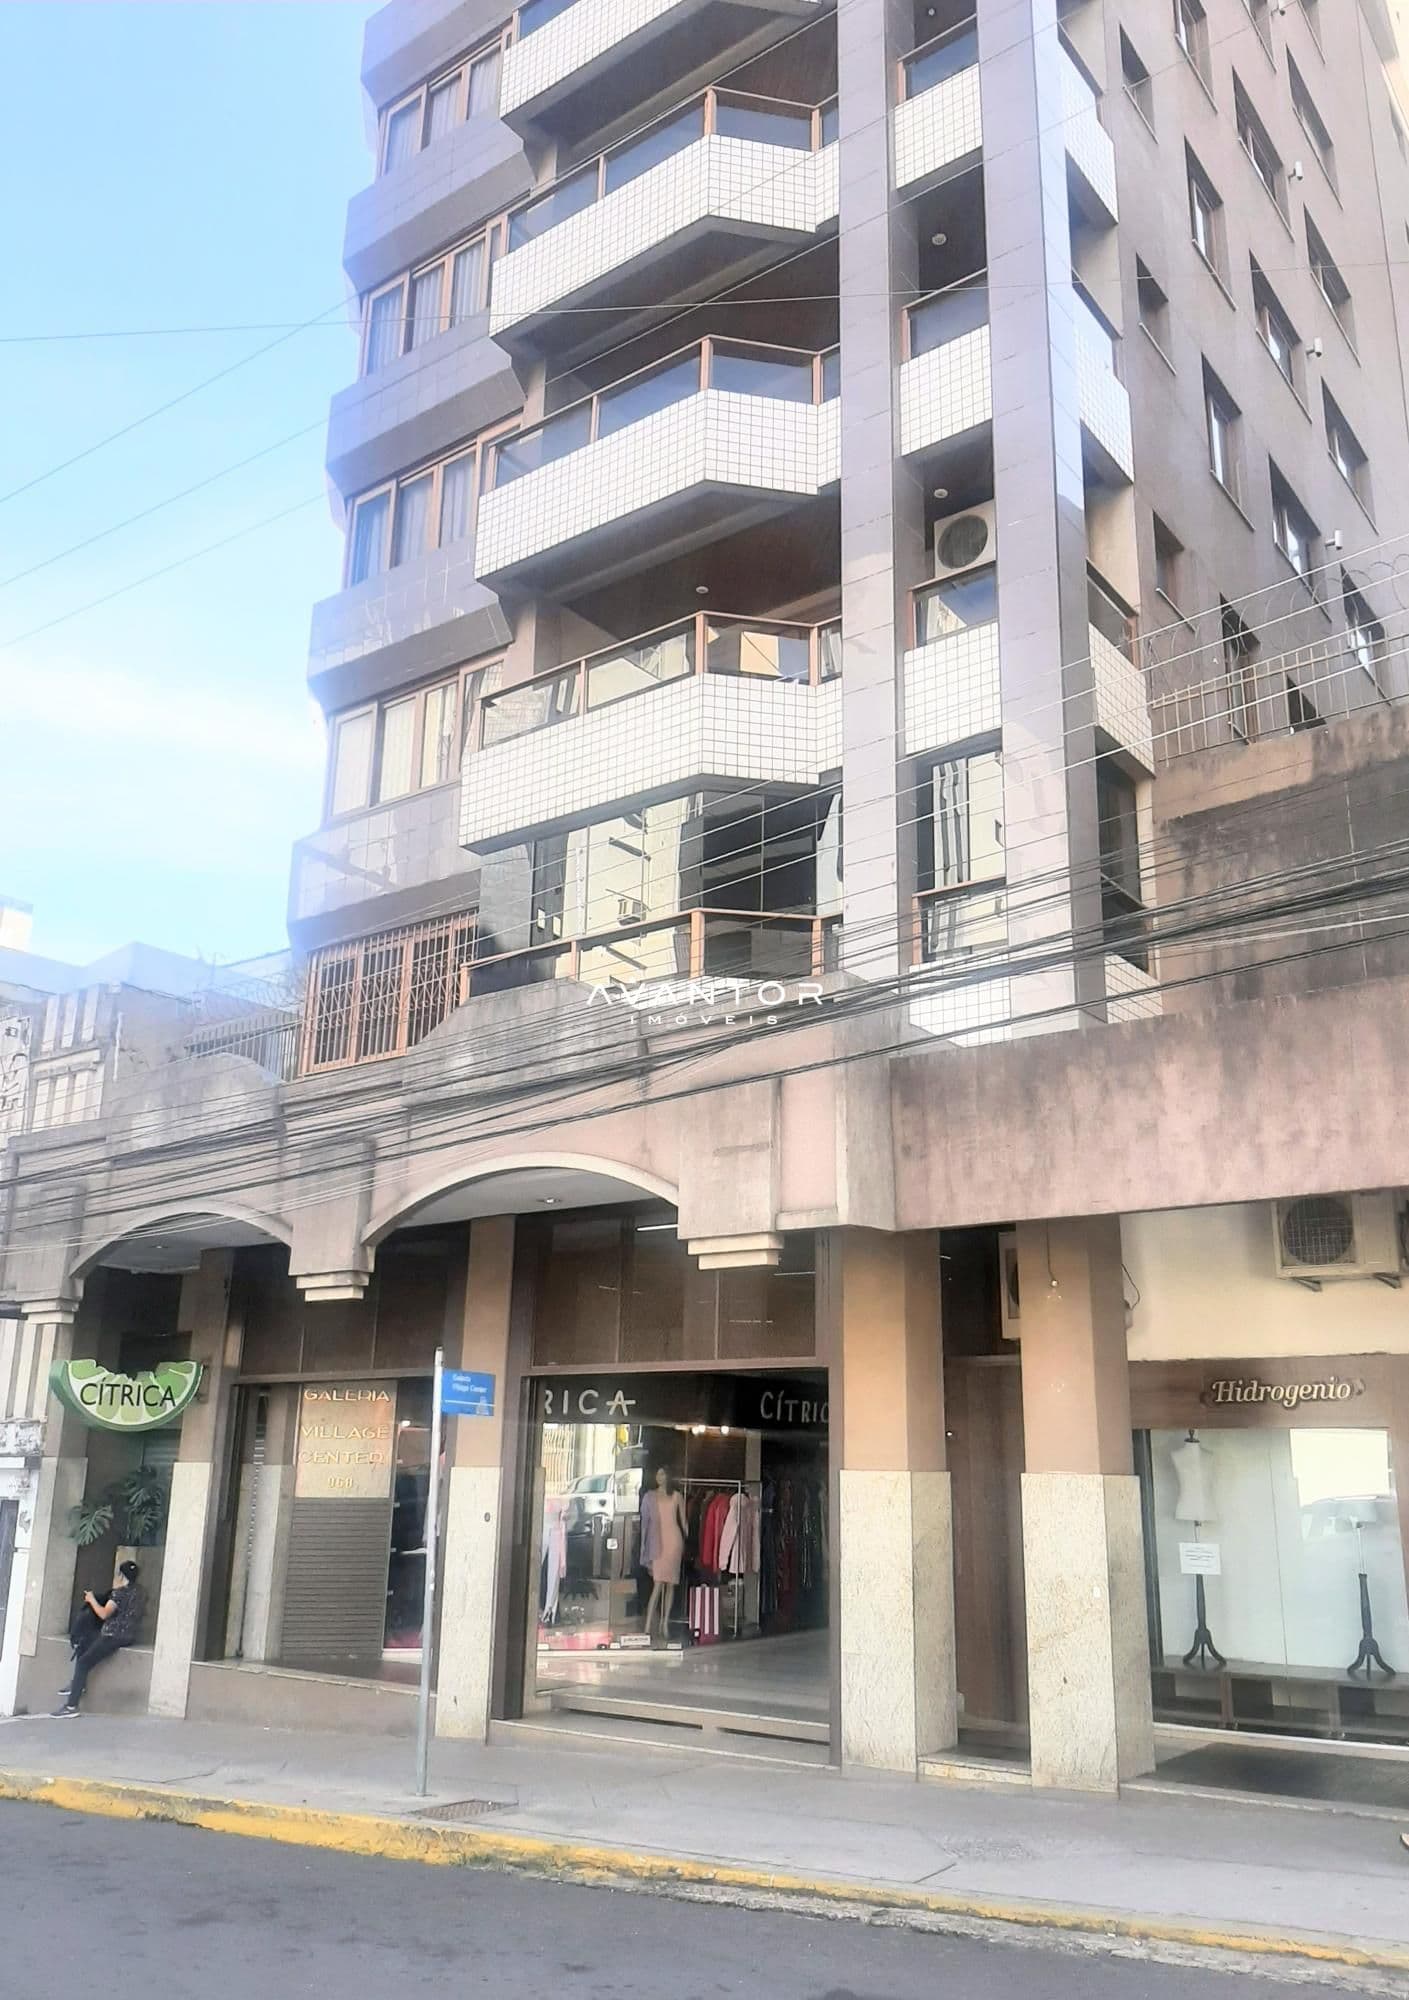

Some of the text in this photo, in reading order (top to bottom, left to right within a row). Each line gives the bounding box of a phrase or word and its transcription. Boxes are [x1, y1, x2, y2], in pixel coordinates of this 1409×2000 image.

[80, 1377, 176, 1407] CÍTRICA
[304, 1389, 390, 1401] GALERIA
[1212, 1376, 1351, 1408] Hidrogenio
[301, 1424, 389, 1439] VILLAGE
[298, 1450, 385, 1465] CENTER
